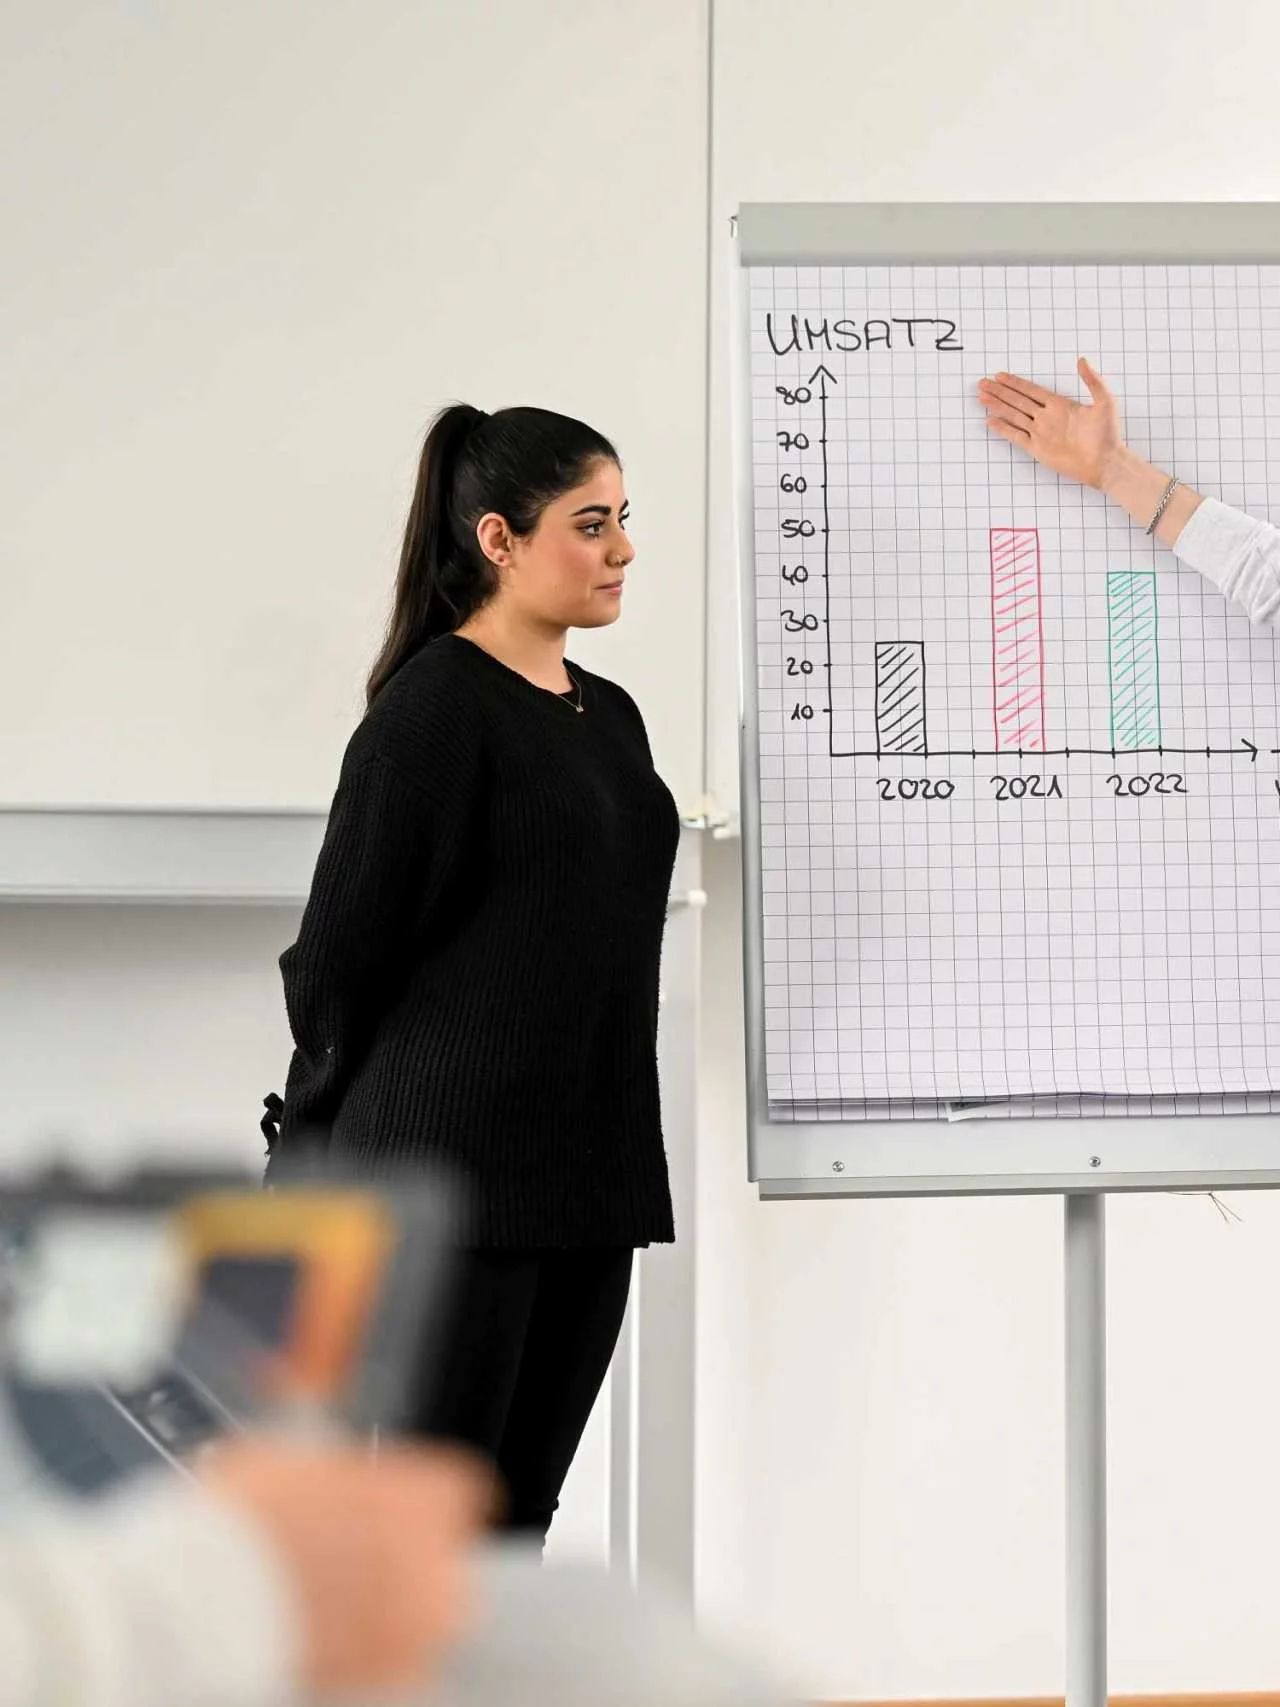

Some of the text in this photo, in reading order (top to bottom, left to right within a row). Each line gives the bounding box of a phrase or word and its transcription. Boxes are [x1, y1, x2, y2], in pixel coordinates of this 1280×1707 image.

[767, 313, 964, 355] UMSATZ
[776, 387, 811, 405] 80
[777, 431, 809, 451] 70
[780, 474, 807, 493] 60
[781, 519, 815, 537] 50
[782, 564, 808, 585] 40
[781, 610, 818, 631] 30
[787, 657, 813, 675] 20
[791, 703, 813, 720] 10
[876, 772, 1188, 800] 2020 2021 2022
